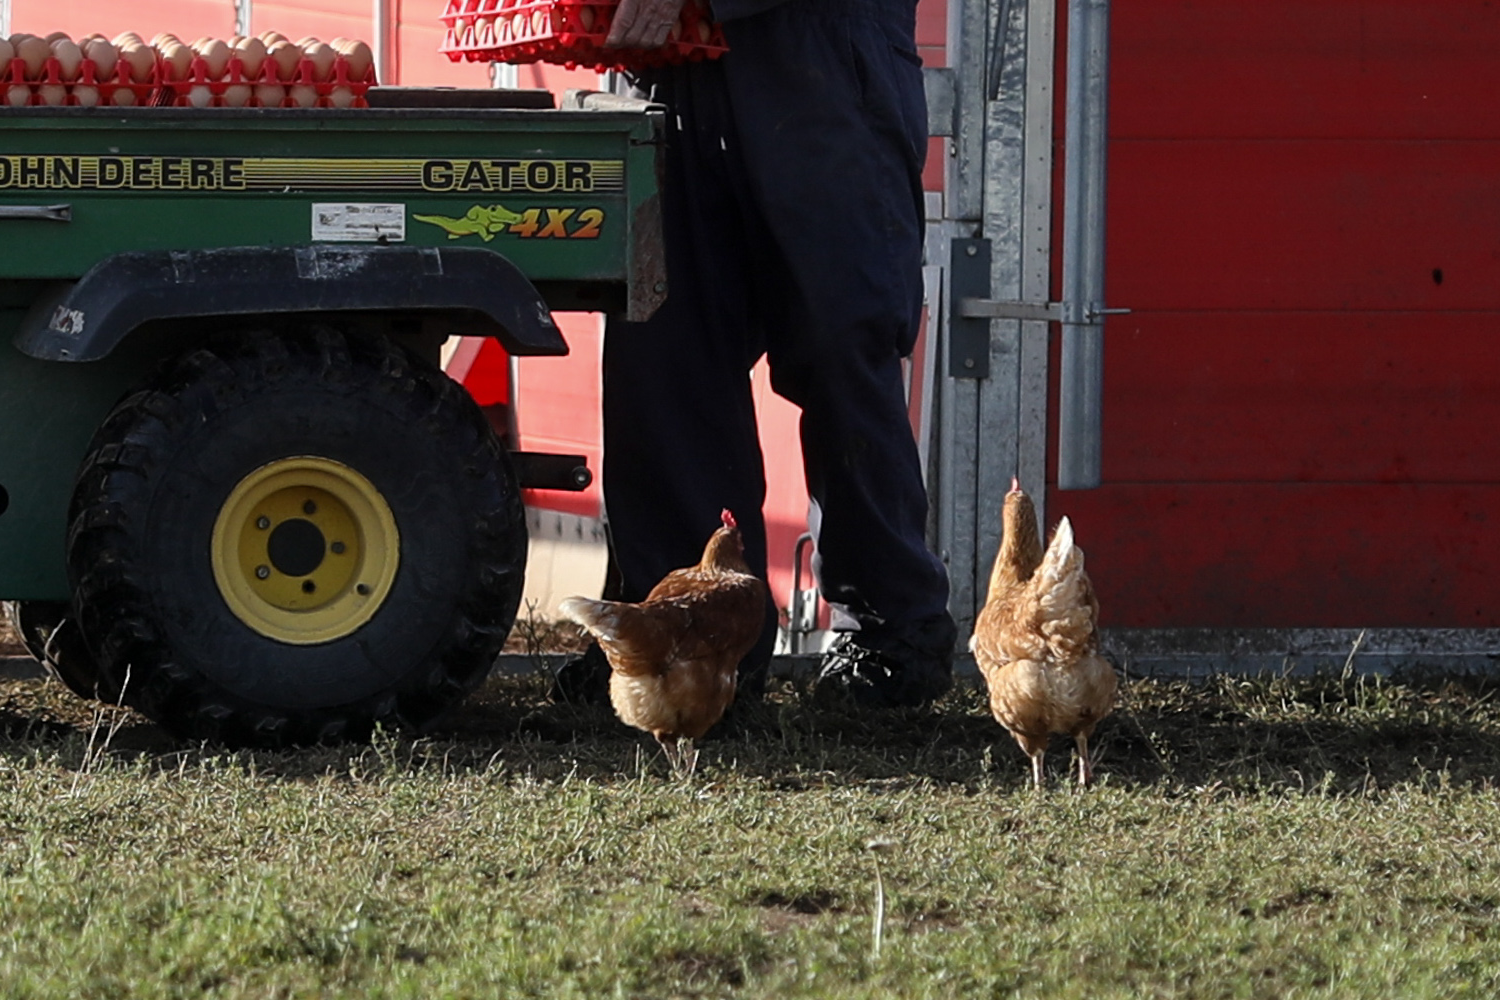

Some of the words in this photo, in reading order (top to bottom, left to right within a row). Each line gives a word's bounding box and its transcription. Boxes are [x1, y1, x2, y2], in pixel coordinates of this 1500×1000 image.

[97, 157, 246, 190] DEERE
[421, 160, 594, 192] GATOR
[508, 207, 605, 238] 4X2
